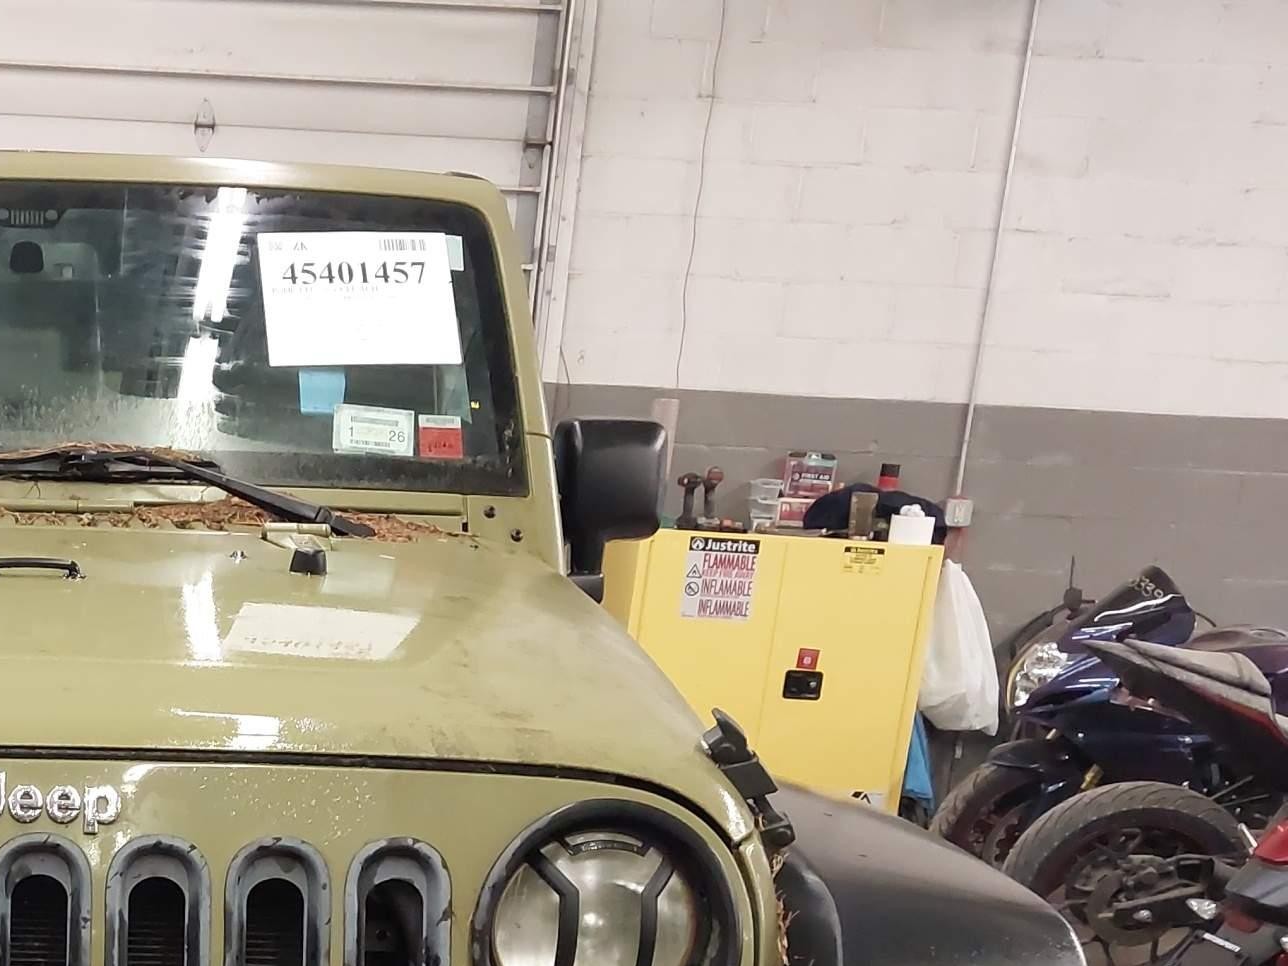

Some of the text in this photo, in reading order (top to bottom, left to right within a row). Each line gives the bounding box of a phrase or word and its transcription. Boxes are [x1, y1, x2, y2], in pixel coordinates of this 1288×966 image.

[282, 261, 425, 285] 45401457
[388, 430, 406, 443] 26
[705, 539, 756, 552] Justrite
[703, 553, 757, 571] FLAMMABLE
[701, 579, 754, 596] INFLAMABLE
[697, 599, 750, 617] INFLAMMABLE
